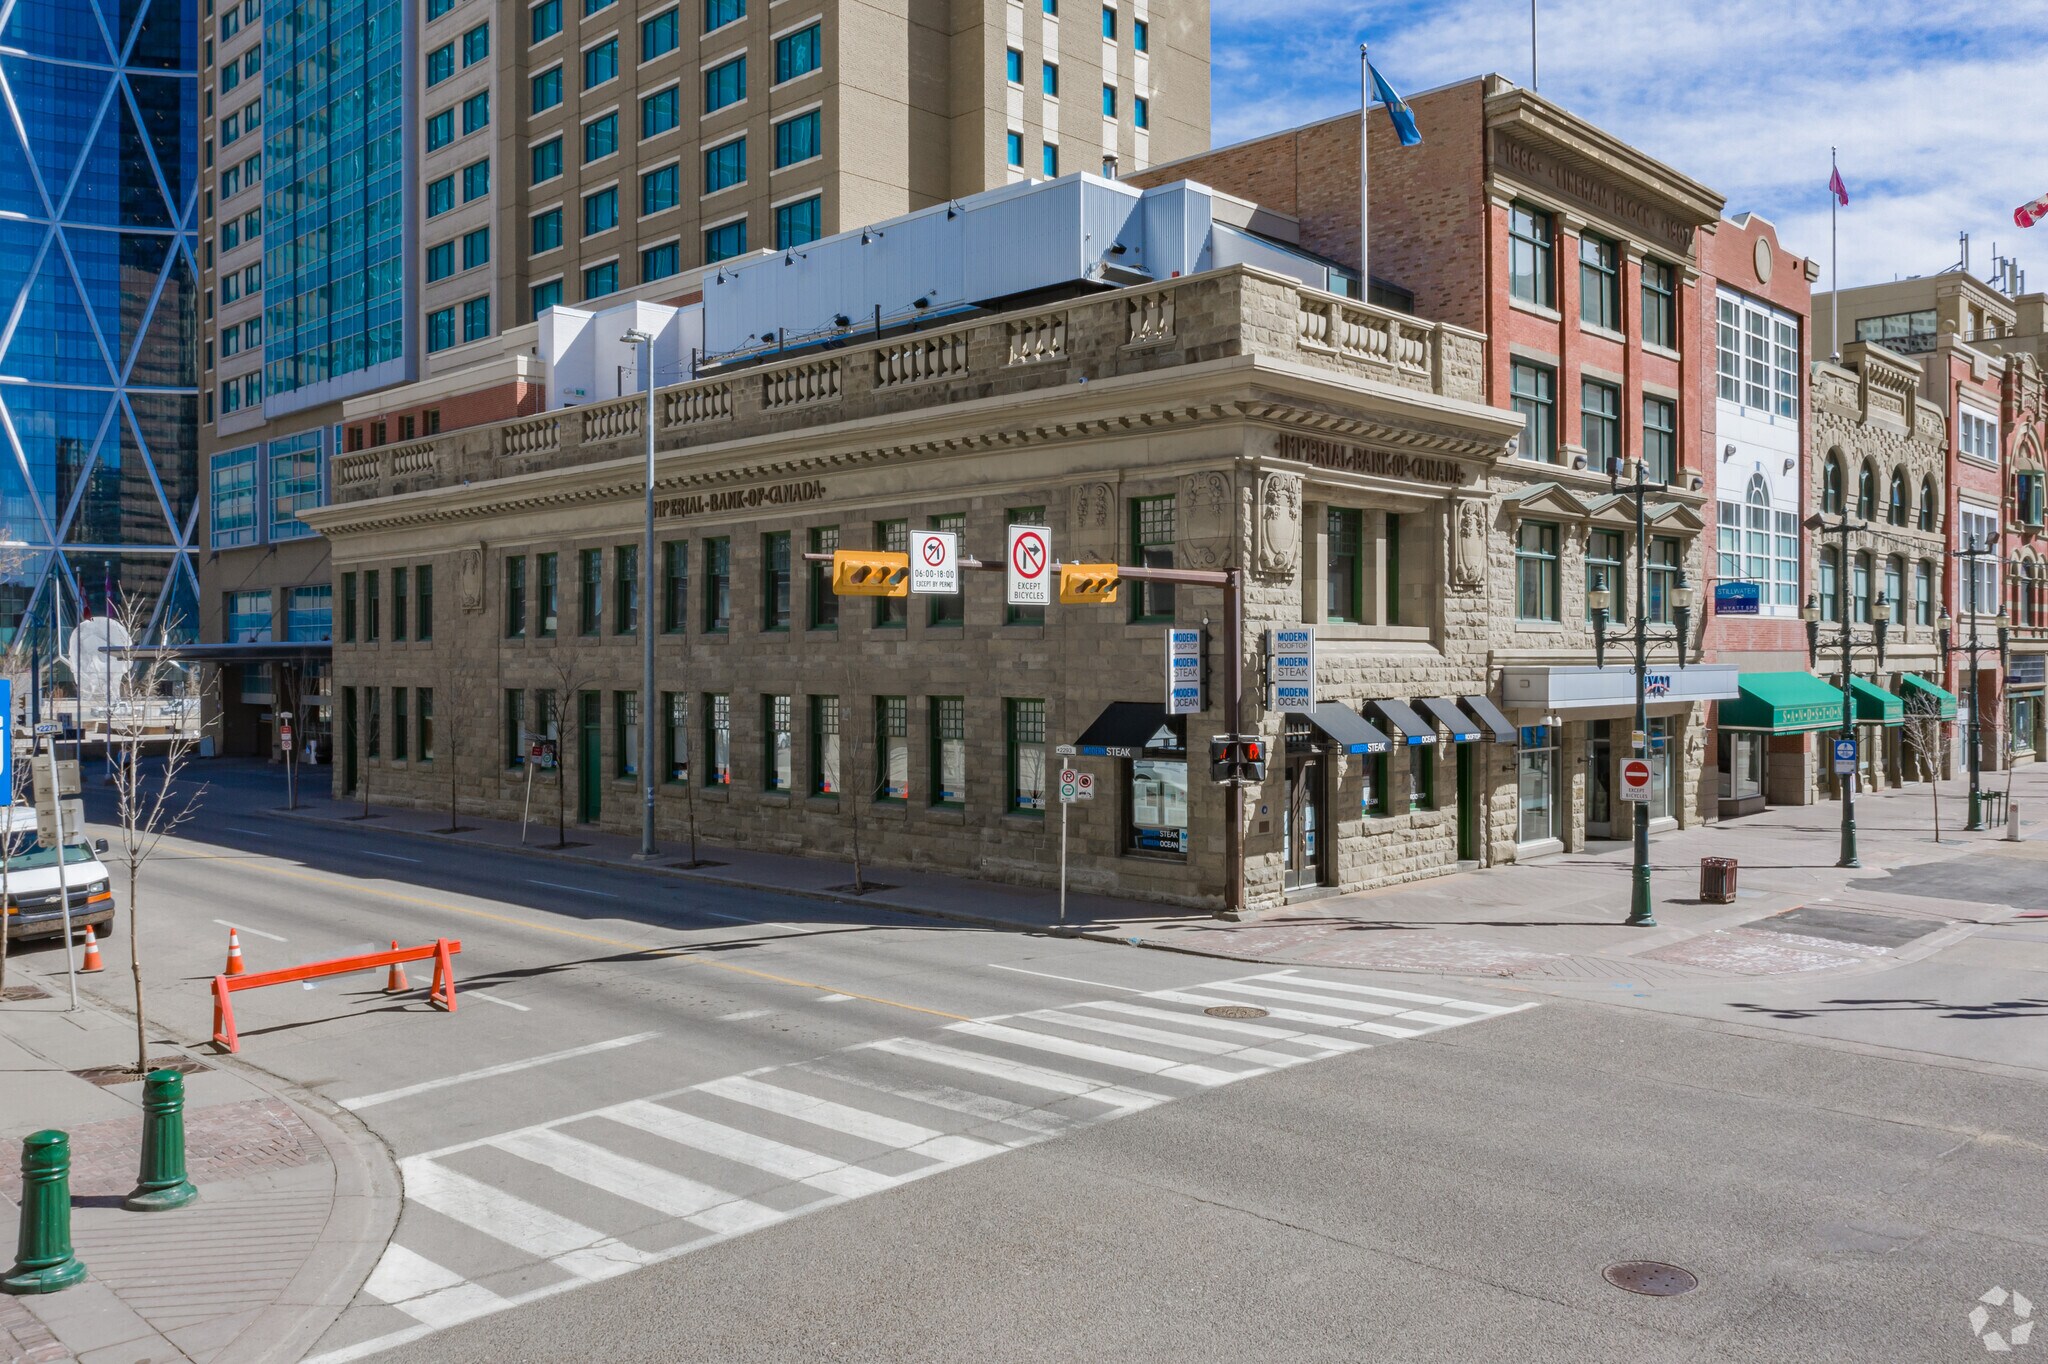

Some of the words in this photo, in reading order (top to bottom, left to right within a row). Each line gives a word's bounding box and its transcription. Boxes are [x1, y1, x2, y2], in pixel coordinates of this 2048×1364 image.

[1556, 166, 1608, 210] LINEHAM
[1614, 194, 1650, 230] BLOCK
[1666, 221, 1691, 247] 1907
[1278, 433, 1350, 468] IMPERIAL
[1352, 447, 1390, 475] BANK
[1391, 454, 1409, 477] OF
[1410, 457, 1463, 484] CANADA
[654, 495, 704, 518] MPERIAL
[709, 489, 745, 513] BANK
[747, 486, 766, 507] OF
[767, 479, 823, 504] CANADA
[914, 569, 955, 579] 06:00-18:00
[916, 580, 931, 588] EXCEPT
[932, 580, 938, 588] BY
[939, 580, 954, 588] PERMIT
[1017, 581, 1041, 590] EXCEPT
[1014, 591, 1045, 600] BICYCLES
[1717, 587, 1757, 595] STILLWATER
[1173, 632, 1198, 643] MODERN
[1277, 632, 1308, 642] MODERN
[1173, 657, 1198, 668] MODERN
[1277, 657, 1308, 667] MODERN
[1174, 667, 1198, 678] STEAK
[1278, 667, 1308, 677] STEAK
[1173, 687, 1199, 698] MODERN
[1277, 687, 1309, 697] MODERN
[1174, 698, 1199, 708] OCEAN
[1278, 697, 1309, 707] OCEAN
[40, 724, 58, 732] 2271
[1421, 735, 1437, 744] OCEAN
[1082, 746, 1106, 755] MODERN
[1106, 747, 1131, 757] STEAK
[1350, 743, 1368, 754] MODERN
[1368, 742, 1386, 753] STEAK
[1159, 831, 1179, 839] STEAK
[1159, 840, 1179, 849] OCEAN
